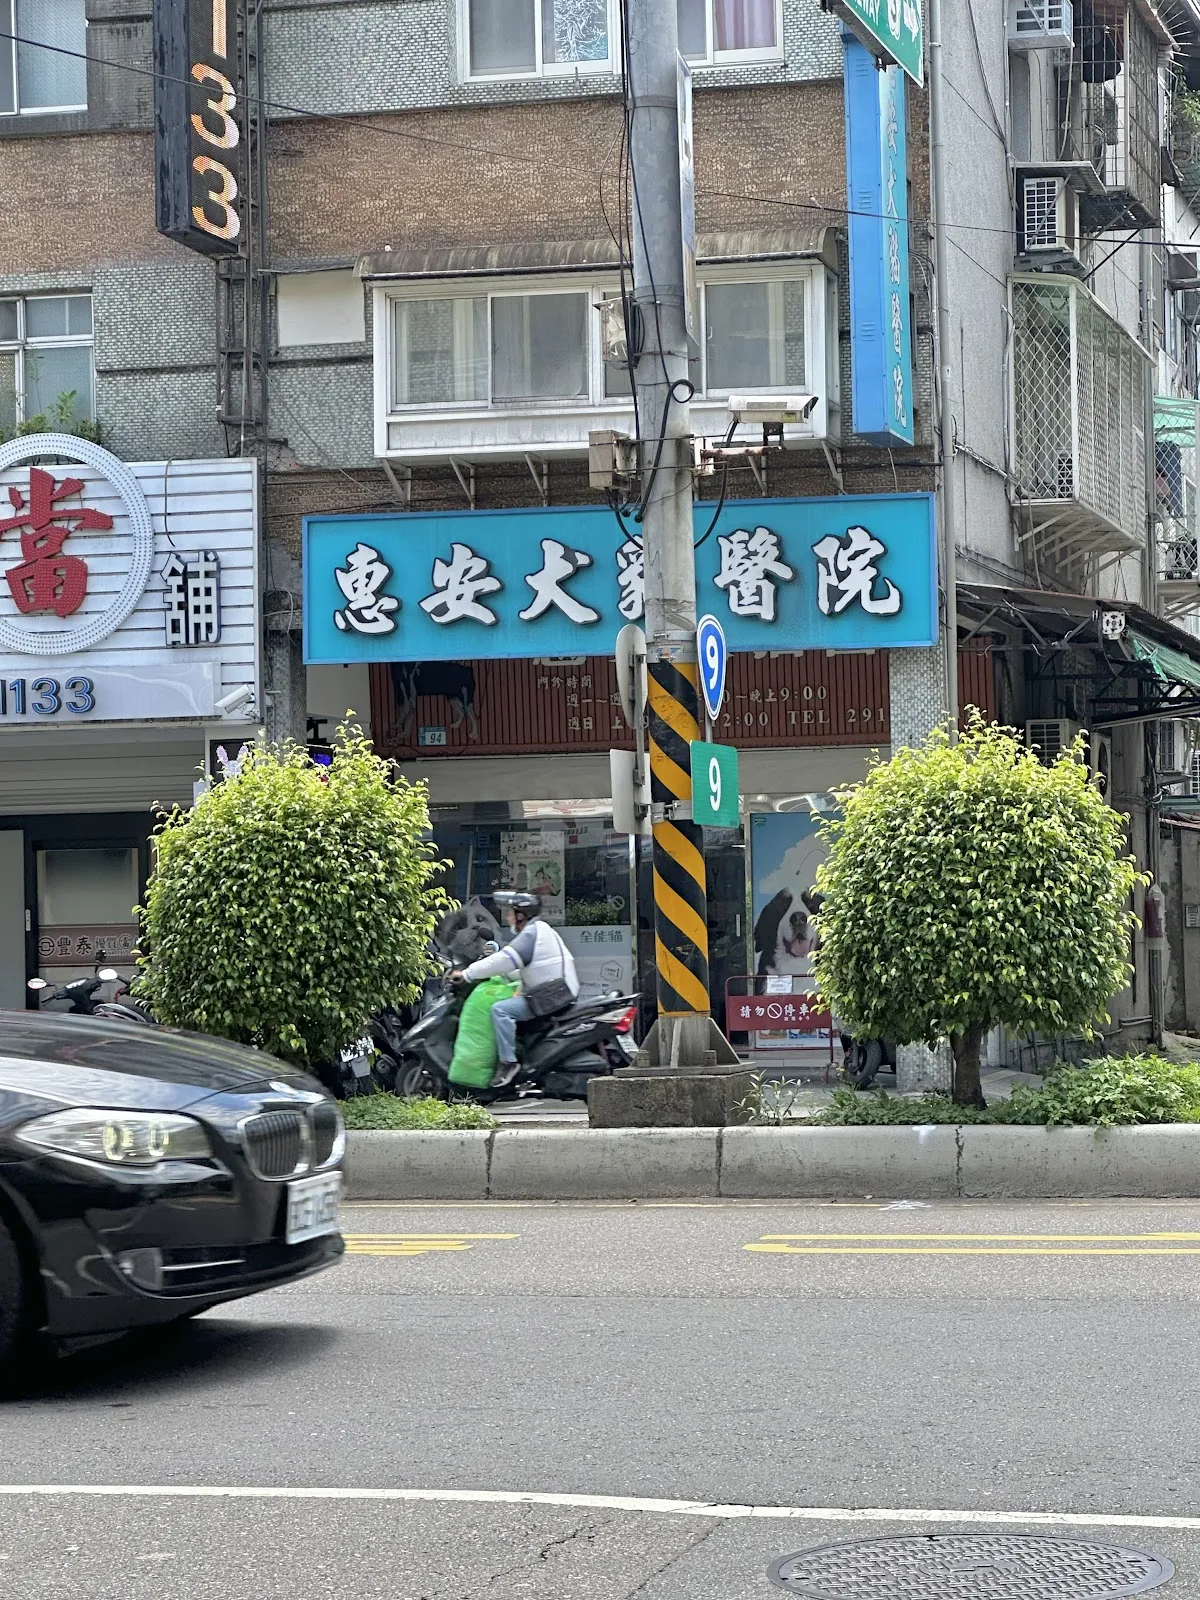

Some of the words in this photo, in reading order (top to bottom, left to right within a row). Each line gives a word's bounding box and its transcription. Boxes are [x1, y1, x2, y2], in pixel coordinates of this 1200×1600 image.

[0, 467, 113, 617] 當
[706, 635, 719, 689] 9
[538, 675, 592, 690] 門診時間
[0, 676, 96, 715] 133
[712, 711, 769, 728] 2:00
[787, 709, 830, 725] TEL
[847, 707, 886, 723] 291
[430, 733, 442, 744] 94
[709, 757, 721, 811] 9
[580, 930, 623, 943] 全能貓
[740, 1005, 765, 1019] 請勿
[784, 1003, 809, 1017] 停車
